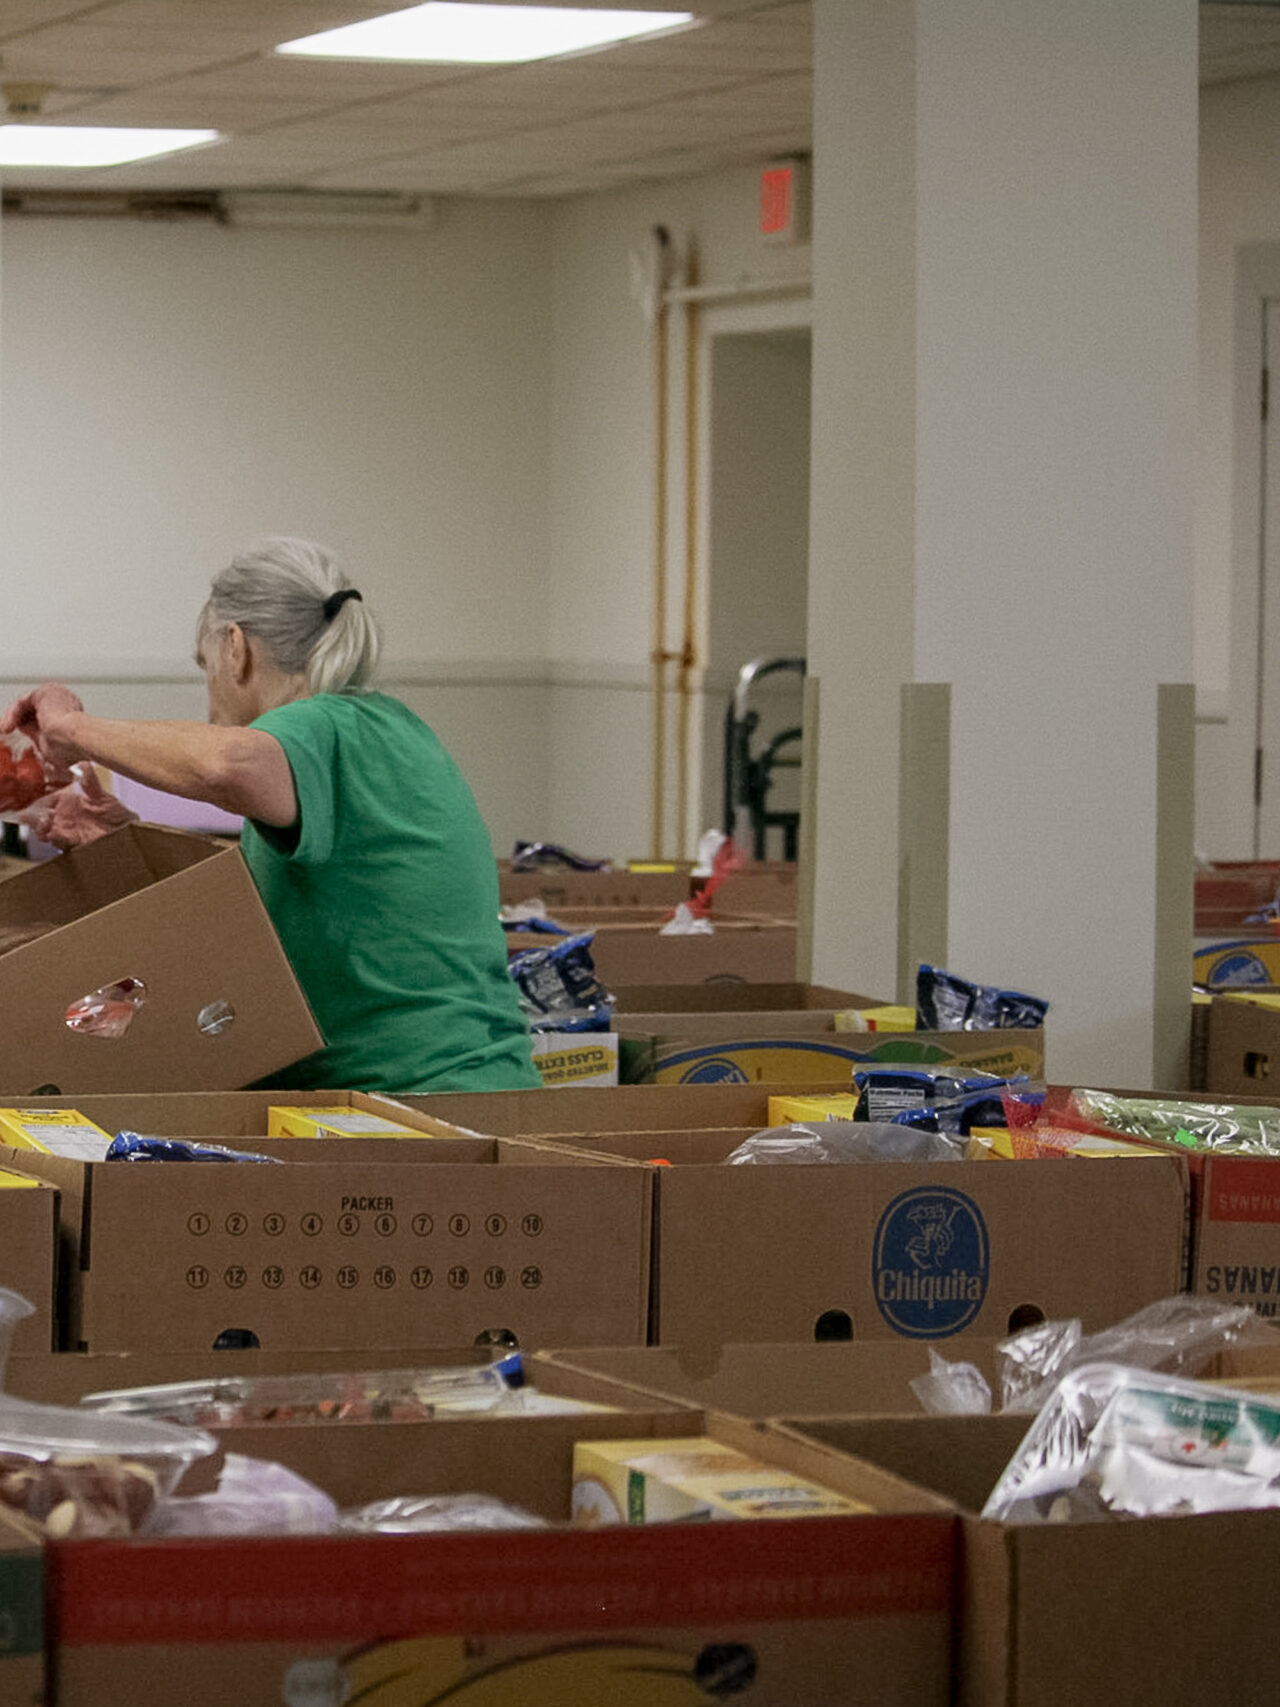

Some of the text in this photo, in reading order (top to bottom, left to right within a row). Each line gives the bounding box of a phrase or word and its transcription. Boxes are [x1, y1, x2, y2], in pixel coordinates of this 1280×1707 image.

[536, 1056, 566, 1070] EXTR
[341, 1196, 393, 1211] PACKER
[877, 1268, 982, 1310] Chiquita
